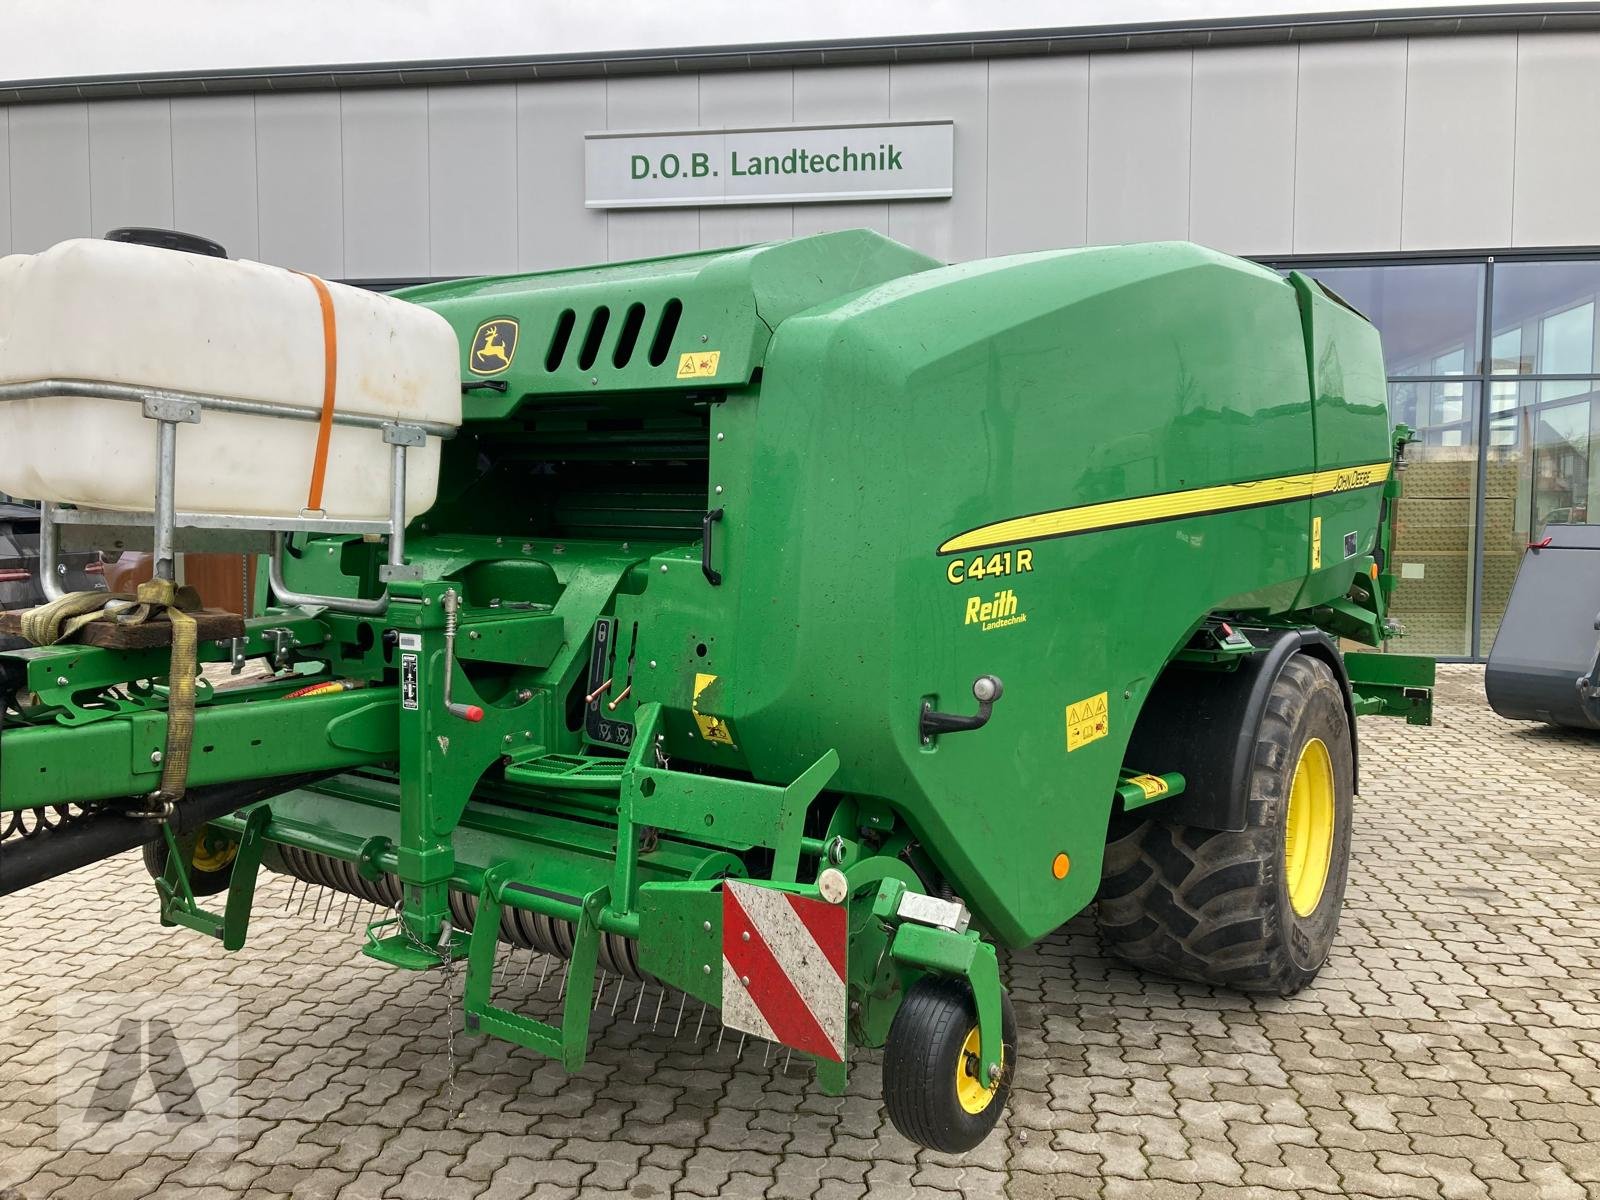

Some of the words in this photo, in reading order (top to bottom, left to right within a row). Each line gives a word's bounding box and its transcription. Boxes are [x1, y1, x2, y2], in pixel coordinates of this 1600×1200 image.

[631, 152, 719, 180] D.O.B.
[731, 144, 903, 176] Landtechnik
[947, 559, 965, 585] C
[967, 551, 1012, 581] 441
[1016, 548, 1033, 574] R
[964, 589, 1018, 625] Reith
[982, 613, 1027, 631] Landtechnik
